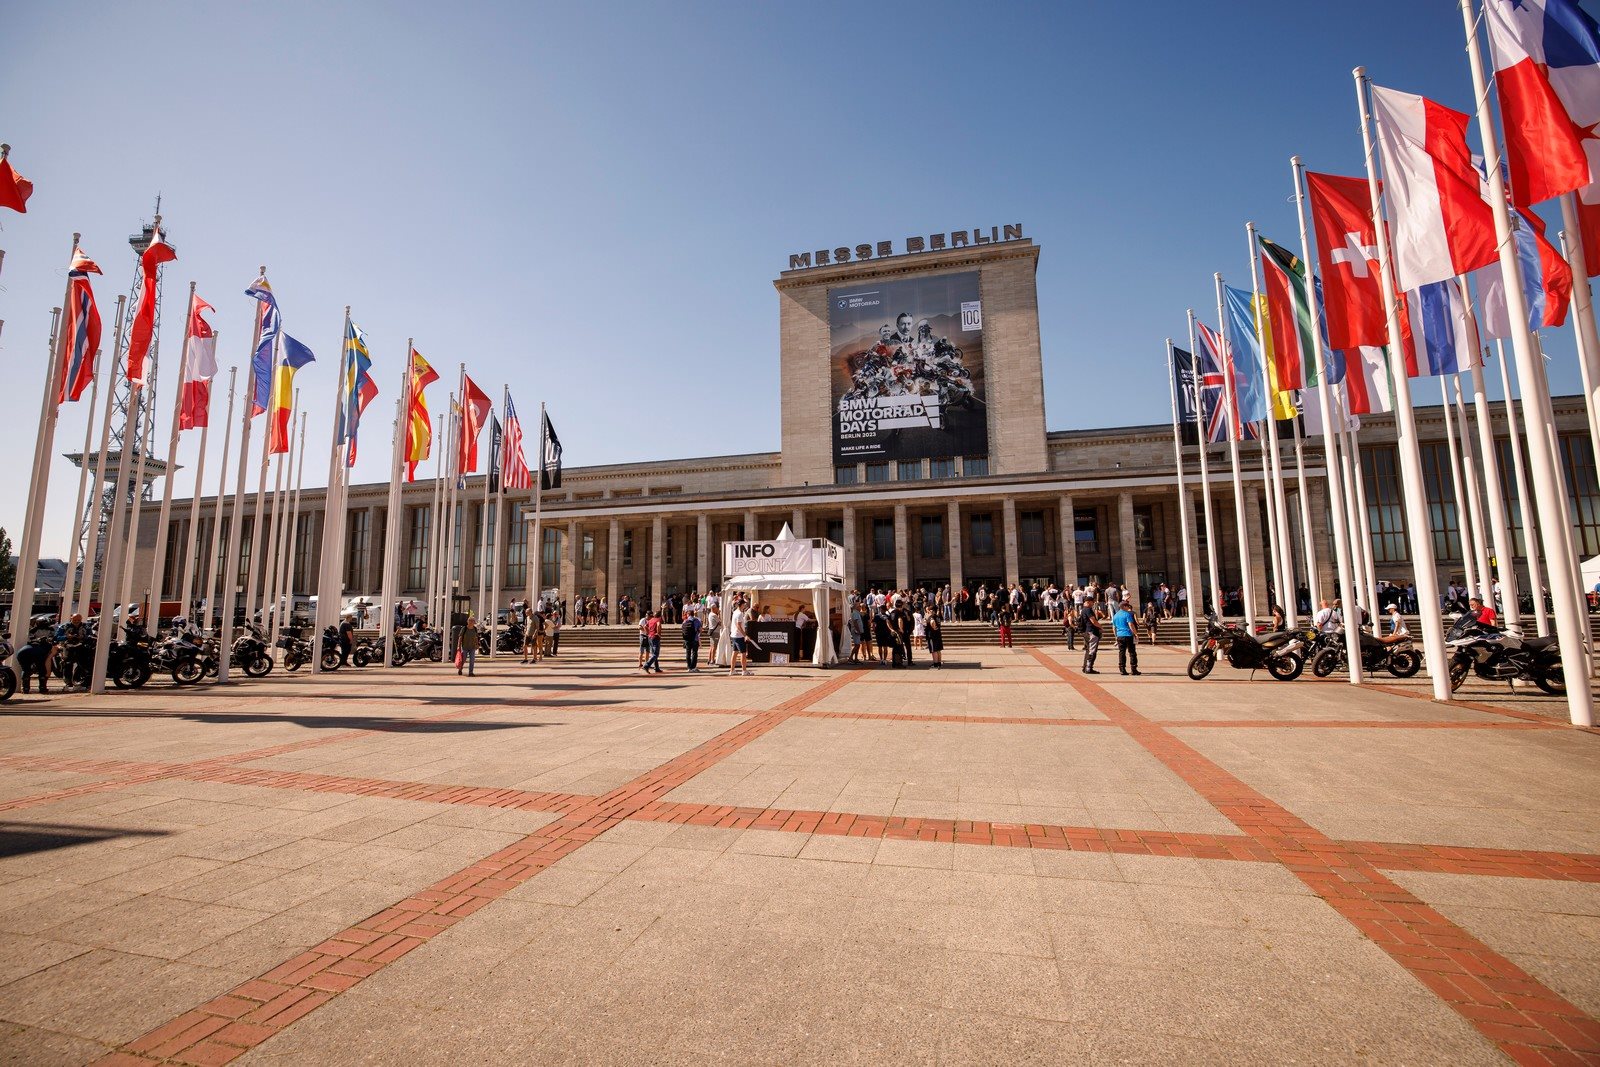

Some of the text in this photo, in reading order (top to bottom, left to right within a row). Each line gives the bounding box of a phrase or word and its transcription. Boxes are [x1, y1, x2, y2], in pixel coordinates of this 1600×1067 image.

[789, 223, 1022, 268] MESSE BERLIN
[849, 300, 880, 308] MOTORRAD
[840, 398, 877, 411] BMW
[840, 405, 924, 422] MOTORRAD
[840, 420, 877, 433] DAYS
[735, 543, 775, 558] INFO
[735, 558, 786, 573] POINT
